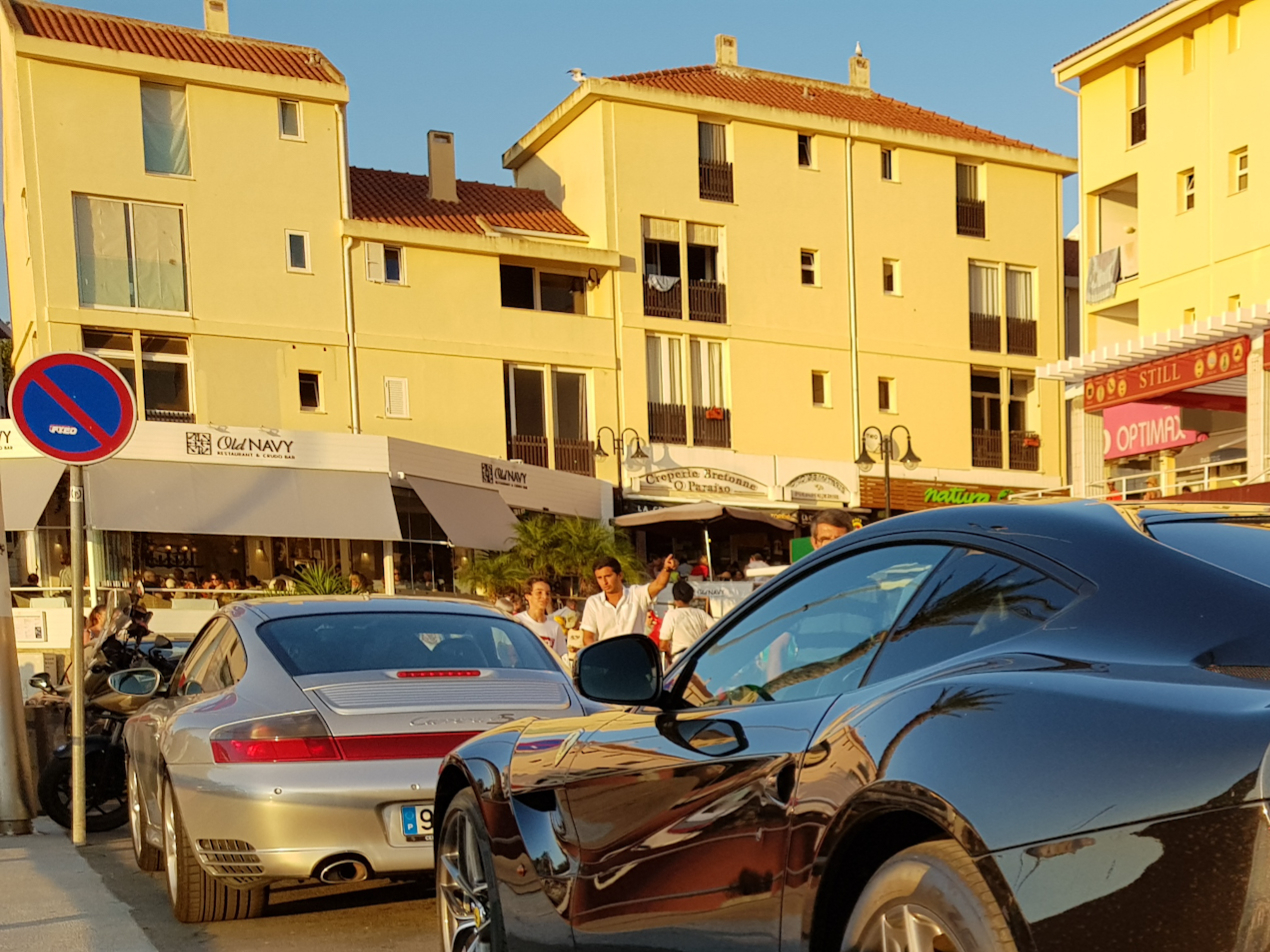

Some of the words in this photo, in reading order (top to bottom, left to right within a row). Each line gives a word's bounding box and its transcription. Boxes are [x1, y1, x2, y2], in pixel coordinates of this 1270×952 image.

[1140, 363, 1181, 389] STILL
[1116, 415, 1186, 452] OPTIMAX
[217, 436, 247, 450] Old
[248, 438, 294, 453] NAVY
[507, 470, 527, 484] NAVY
[645, 468, 700, 485] Creperie
[704, 468, 758, 491] Bretonne
[924, 487, 991, 504] natura
